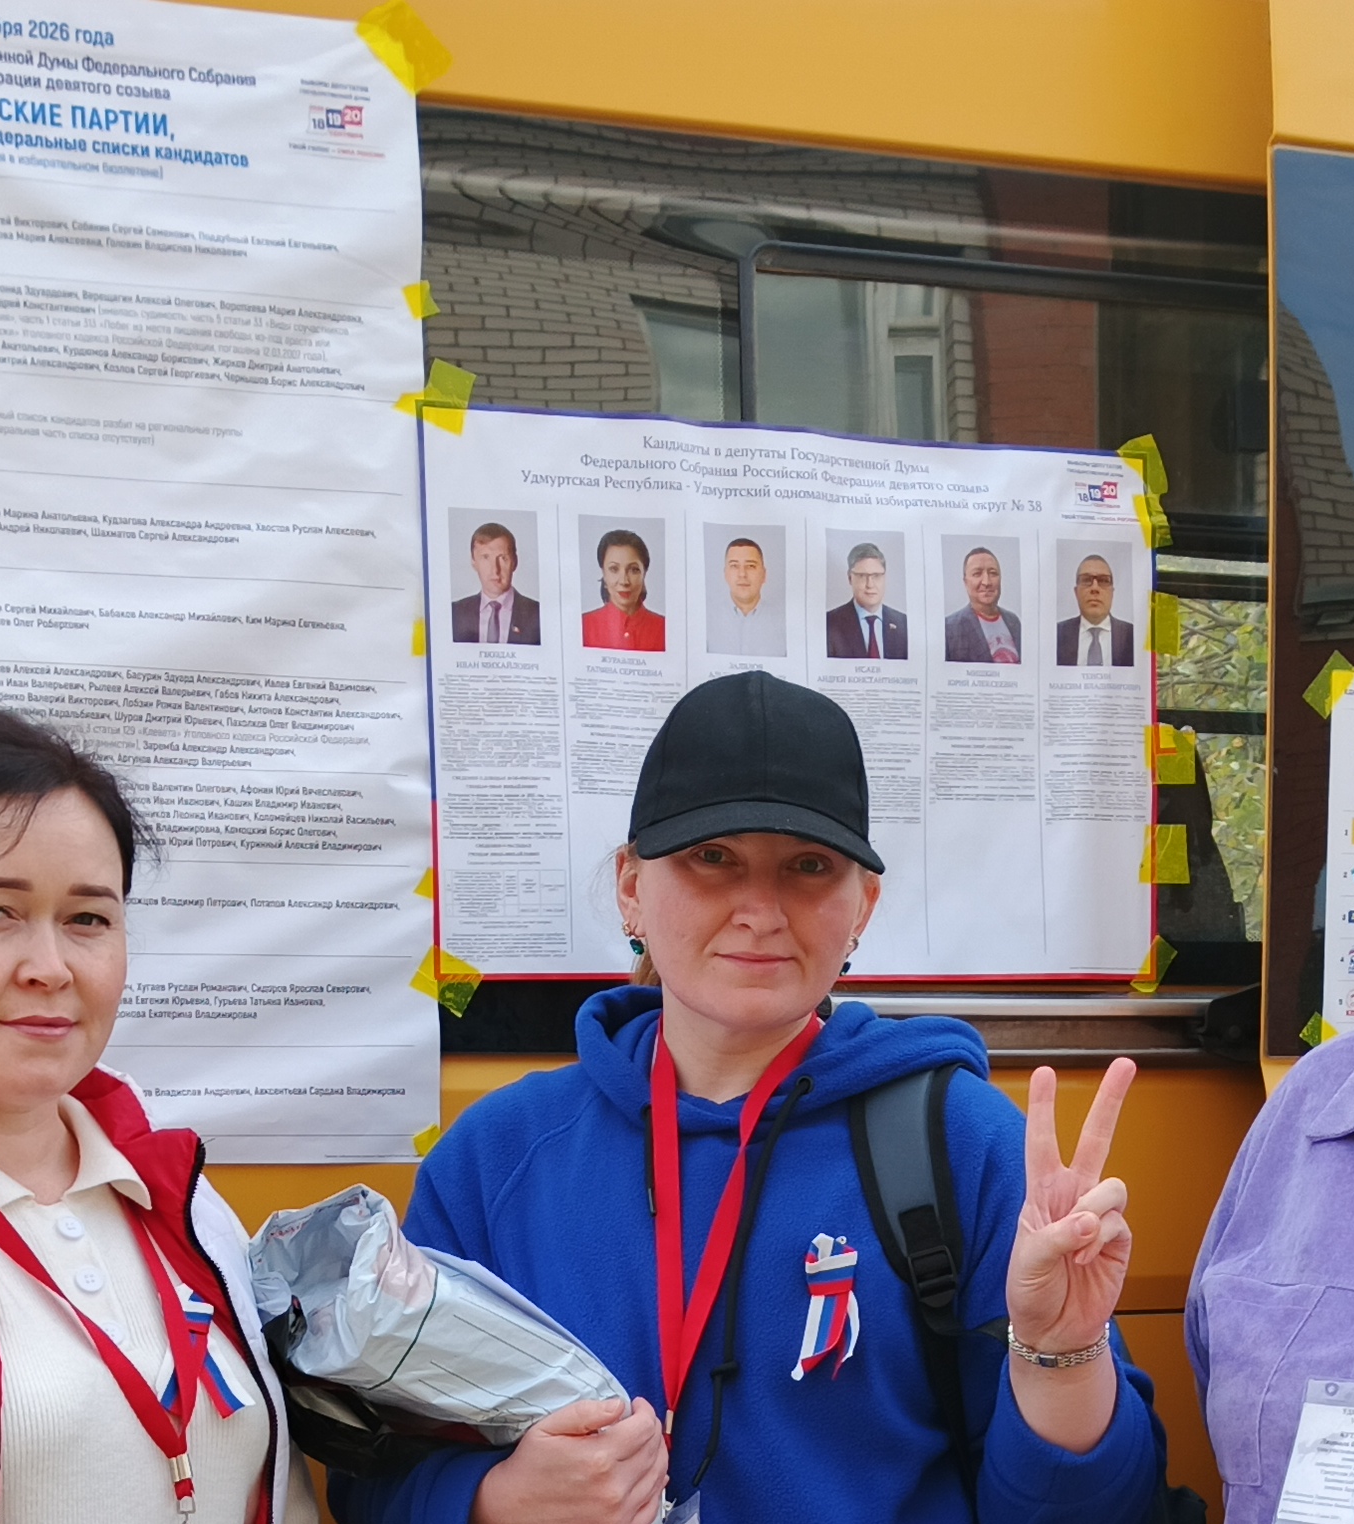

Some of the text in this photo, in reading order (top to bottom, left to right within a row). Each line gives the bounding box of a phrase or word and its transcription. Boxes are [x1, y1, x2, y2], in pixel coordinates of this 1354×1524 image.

[28, 19, 69, 41] 2026
[75, 28, 113, 48] года
[37, 51, 77, 72] Думы
[81, 55, 184, 82] Федерального
[188, 66, 255, 89] Собрания
[45, 77, 111, 97] девятого
[116, 84, 170, 100] созыва
[71, 104, 173, 140] ПАРТИИ,
[345, 110, 361, 121] 20
[92, 140, 149, 158] списки
[155, 146, 248, 169] кандидатов
[643, 435, 928, 476] Кандидаты в депутаты Государственной Думы
[580, 453, 988, 493] Федерального Собрания Российской Федерации девятого созыва
[521, 469, 599, 489] Удмуртская
[604, 474, 682, 493] Республика
[694, 481, 770, 500] Удмуртский
[774, 488, 871, 504] одномандатный
[876, 494, 968, 511] избирательный
[972, 499, 1006, 513] округ
[1011, 499, 1024, 511] №
[1028, 500, 1041, 511] 38
[1102, 485, 1116, 495] 20
